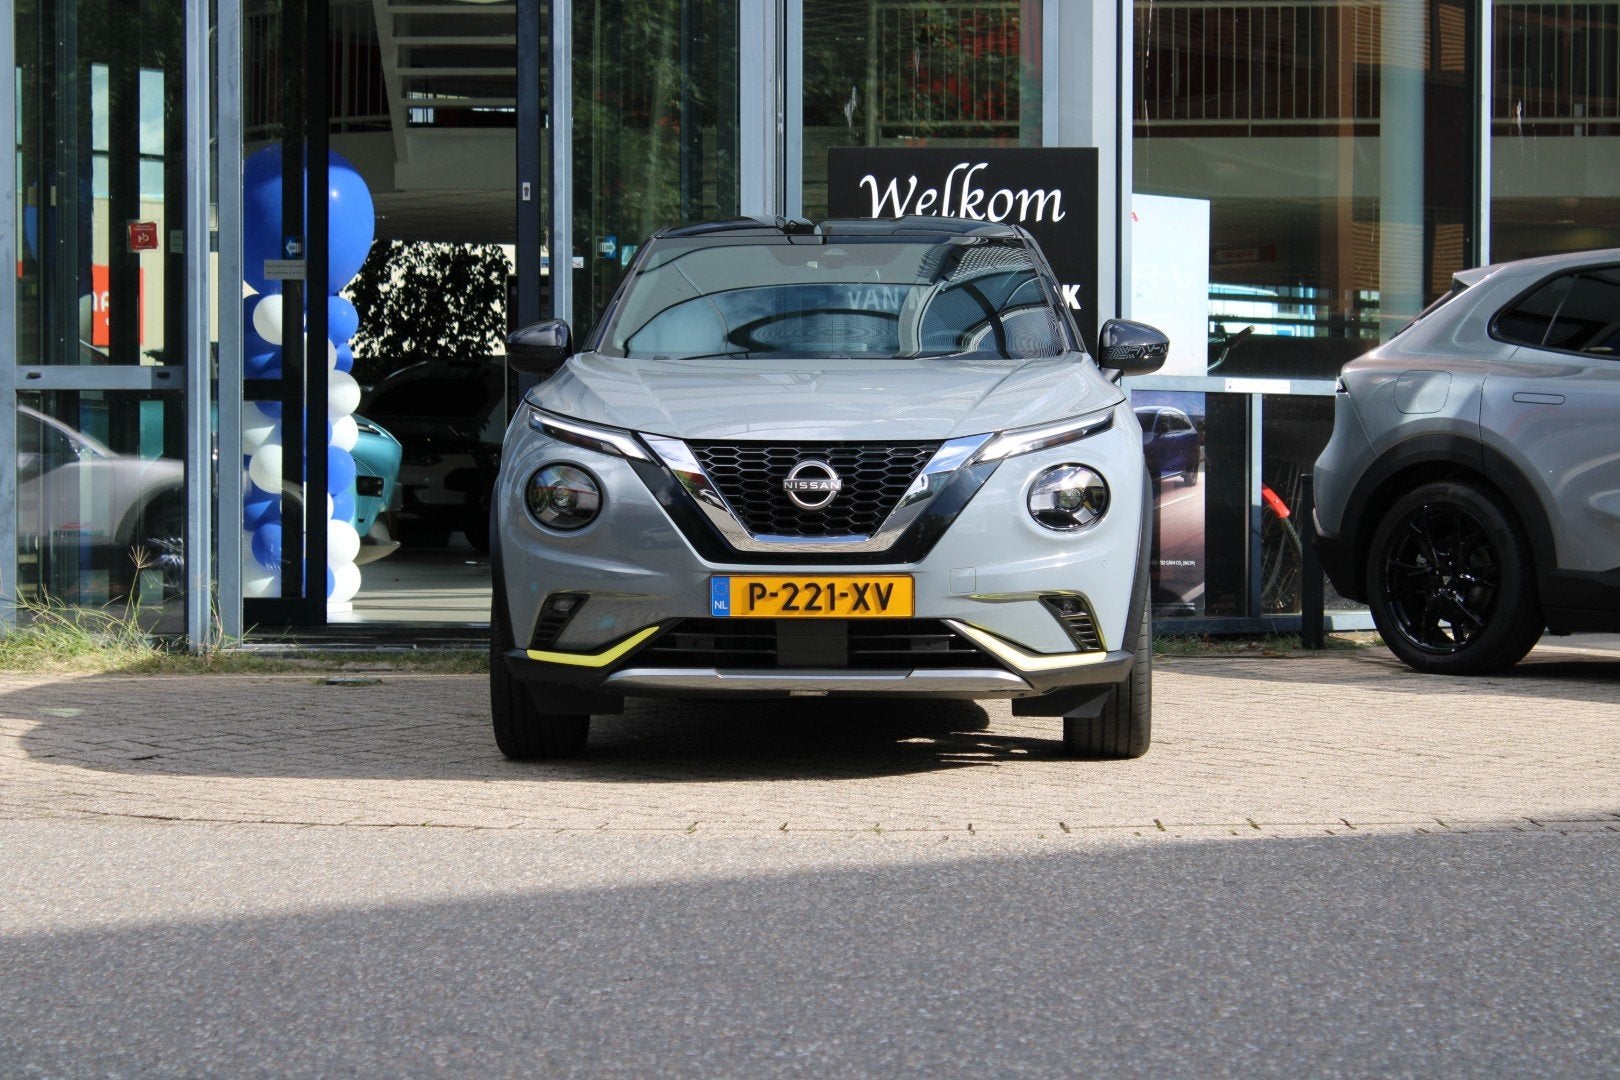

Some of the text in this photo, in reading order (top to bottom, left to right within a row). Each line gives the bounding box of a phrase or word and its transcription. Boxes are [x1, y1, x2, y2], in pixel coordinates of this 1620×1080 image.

[859, 162, 1066, 222] Welkom
[847, 287, 898, 310] VAN
[783, 481, 841, 489] NISSAN
[714, 600, 728, 610] NL
[749, 582, 894, 611] P-221-XV
